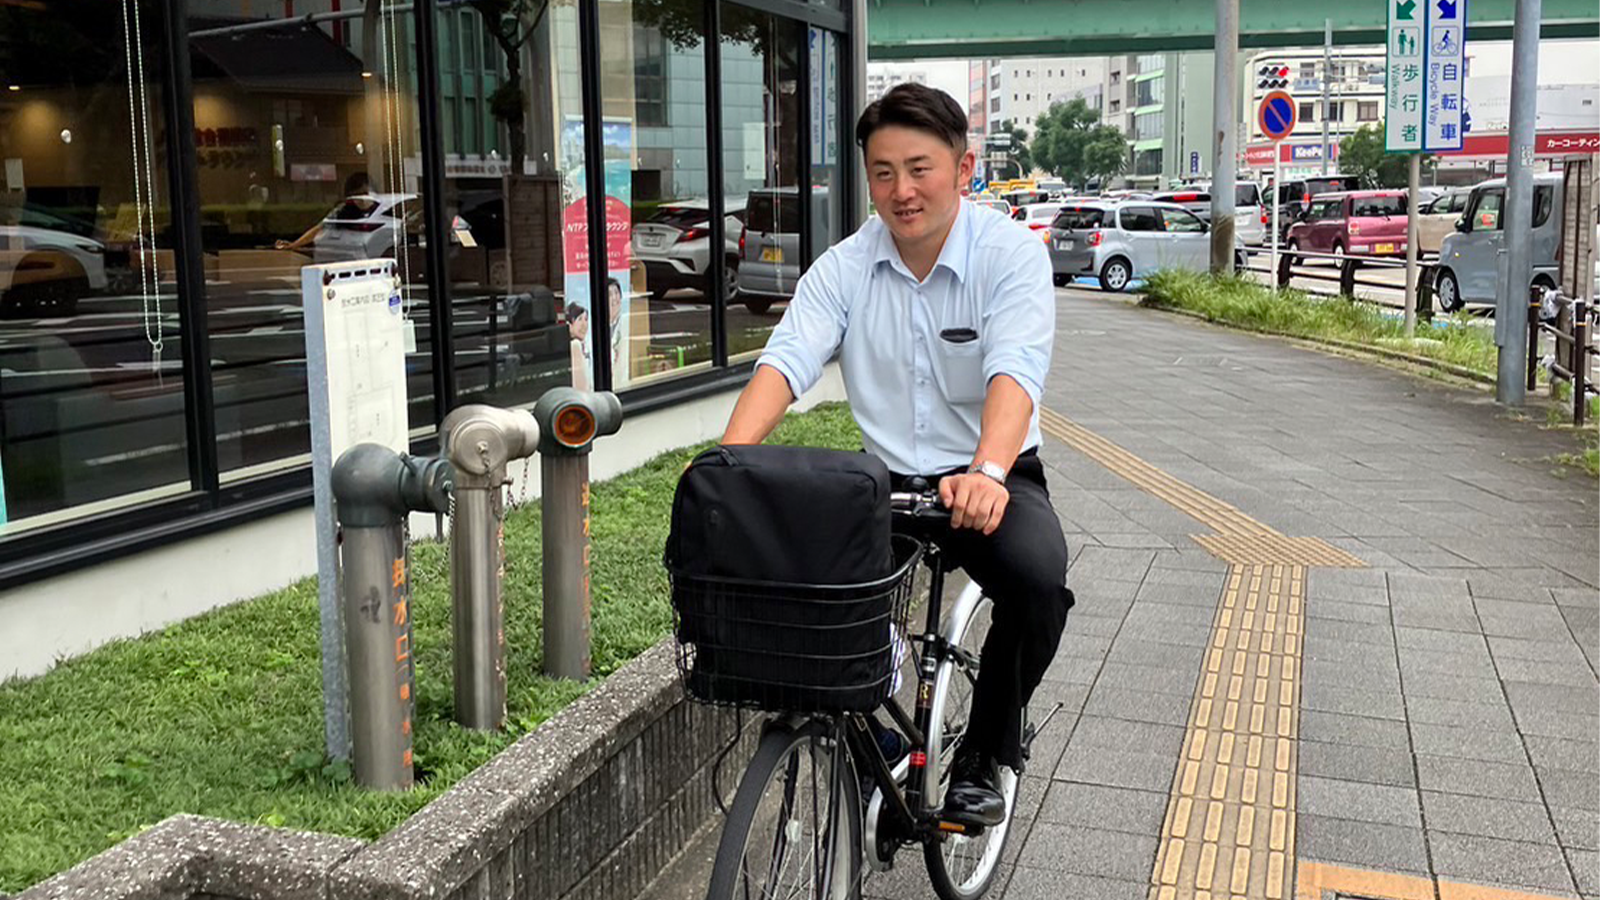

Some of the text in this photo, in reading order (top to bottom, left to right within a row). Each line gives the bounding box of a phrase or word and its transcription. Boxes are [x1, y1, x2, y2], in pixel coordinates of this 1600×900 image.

[1389, 63, 1400, 110] Walkway
[1401, 63, 1418, 142] 歩行者
[1429, 63, 1440, 127] Bicycle Way
[1440, 63, 1458, 141] 自転車
